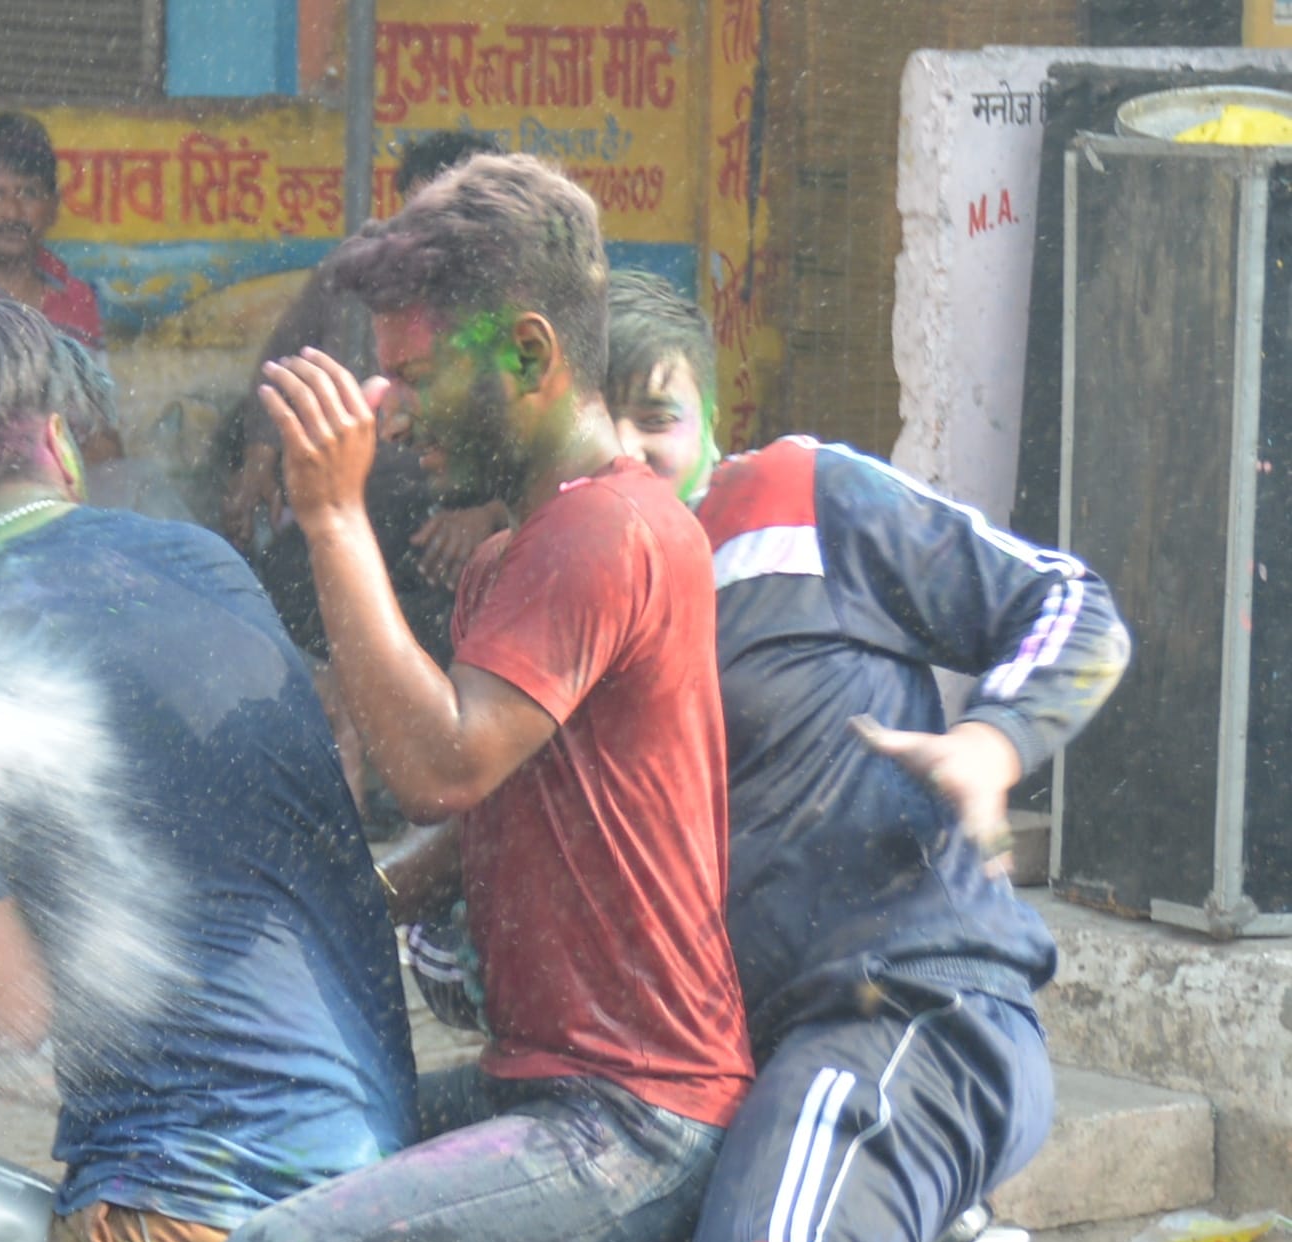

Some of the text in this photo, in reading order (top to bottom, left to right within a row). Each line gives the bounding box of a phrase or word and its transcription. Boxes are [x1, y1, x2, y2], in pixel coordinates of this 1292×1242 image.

[506, 25, 596, 107] ताजा
[601, 1, 677, 109] मीट
[971, 80, 1034, 125] मनोज
[55, 147, 170, 224] याव
